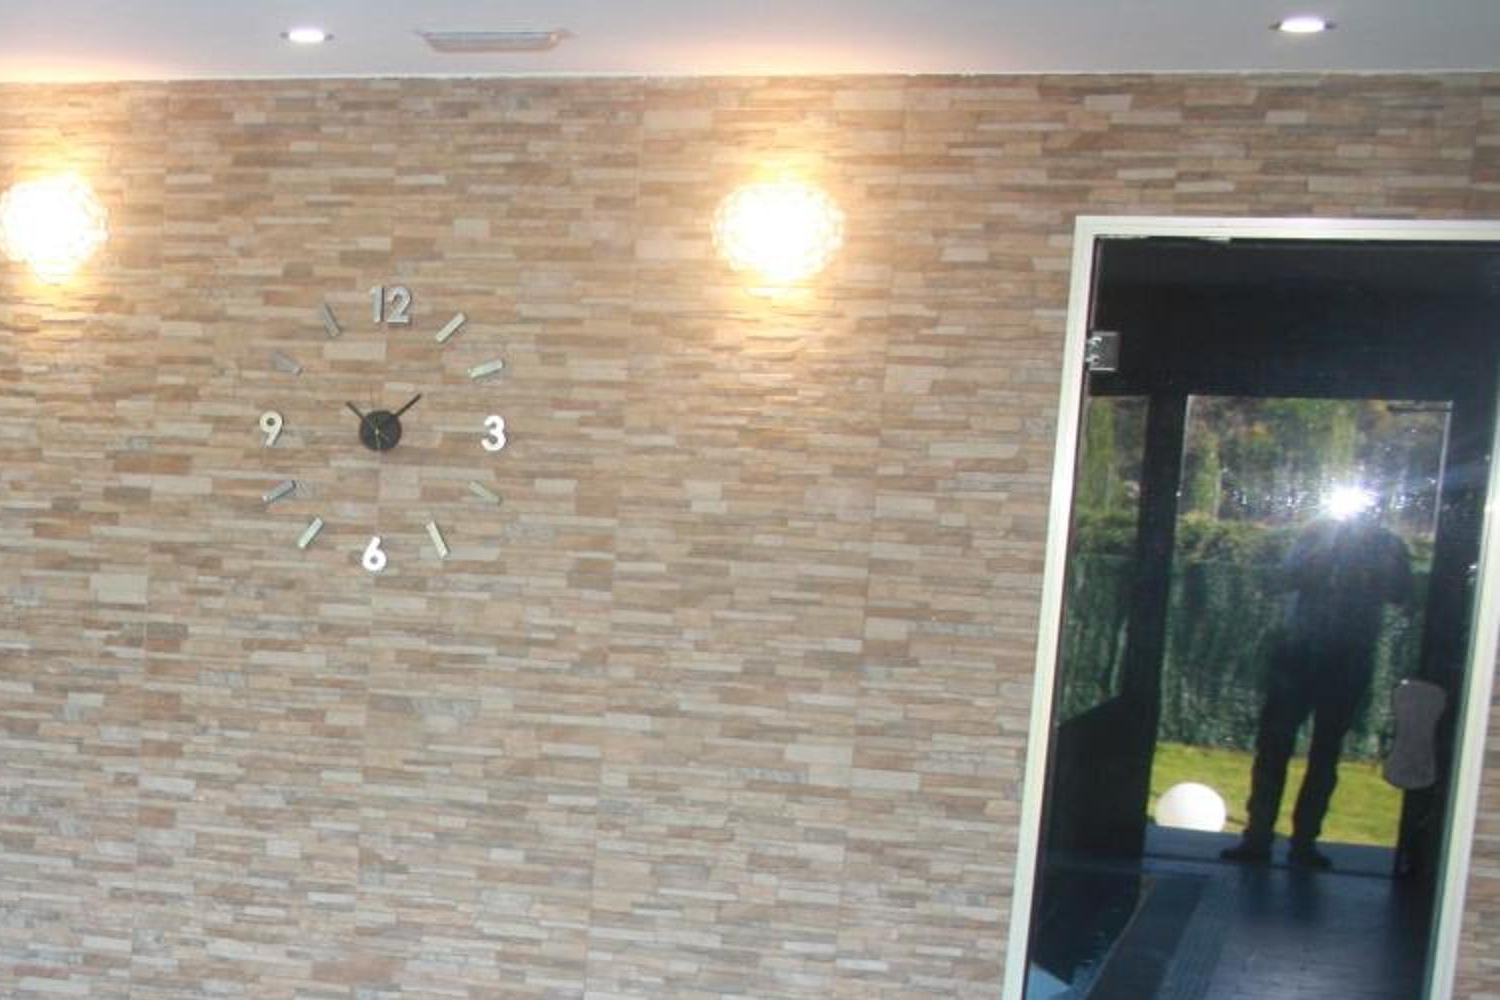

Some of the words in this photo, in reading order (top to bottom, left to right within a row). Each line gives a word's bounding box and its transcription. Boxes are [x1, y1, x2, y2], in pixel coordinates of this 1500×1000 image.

[371, 286, 412, 324] 12
[260, 411, 283, 446] 9
[481, 415, 506, 451] 3
[362, 536, 387, 571] 6
